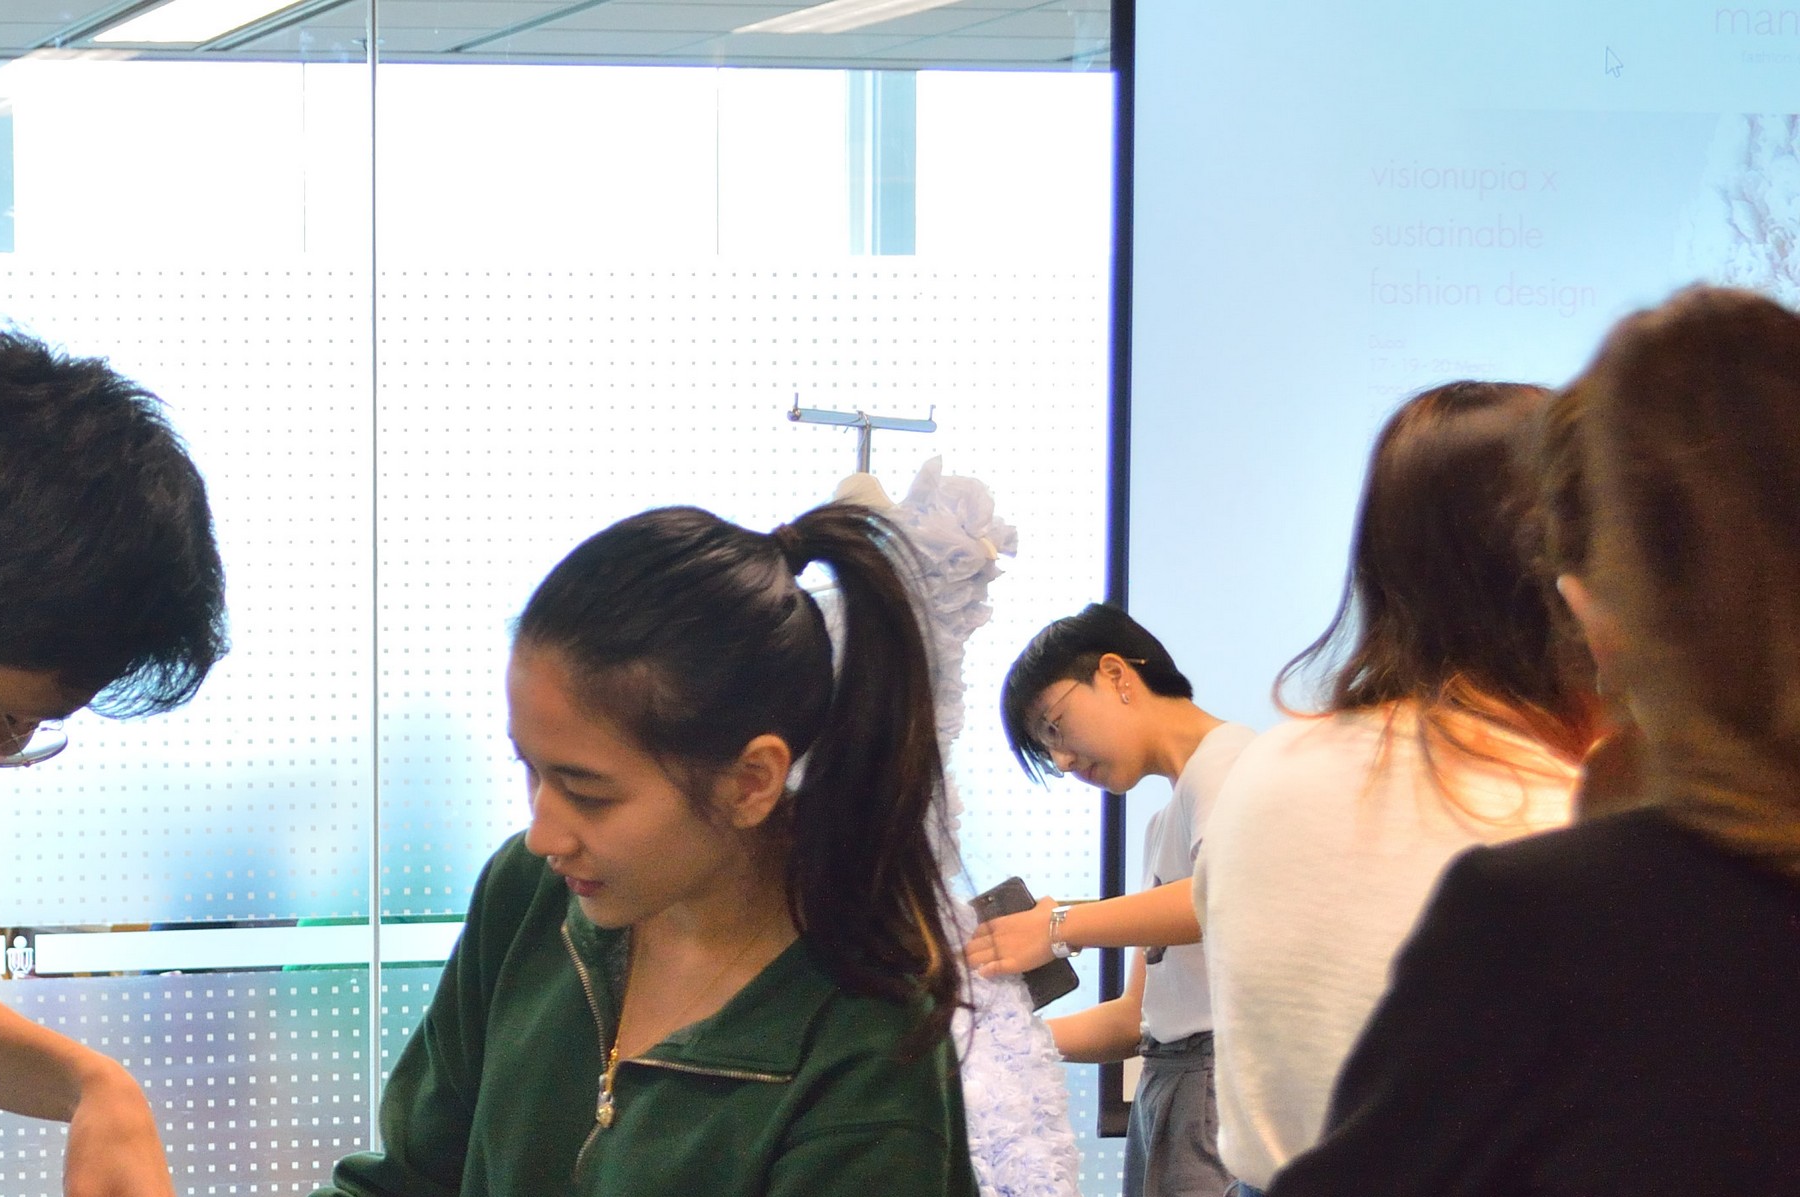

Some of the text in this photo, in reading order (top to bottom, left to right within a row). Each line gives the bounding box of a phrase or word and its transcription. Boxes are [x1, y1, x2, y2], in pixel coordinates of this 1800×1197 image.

[1370, 158, 1559, 202] visionupia x
[1370, 213, 1544, 249] sustainable
[1370, 266, 1596, 319] fashion design
